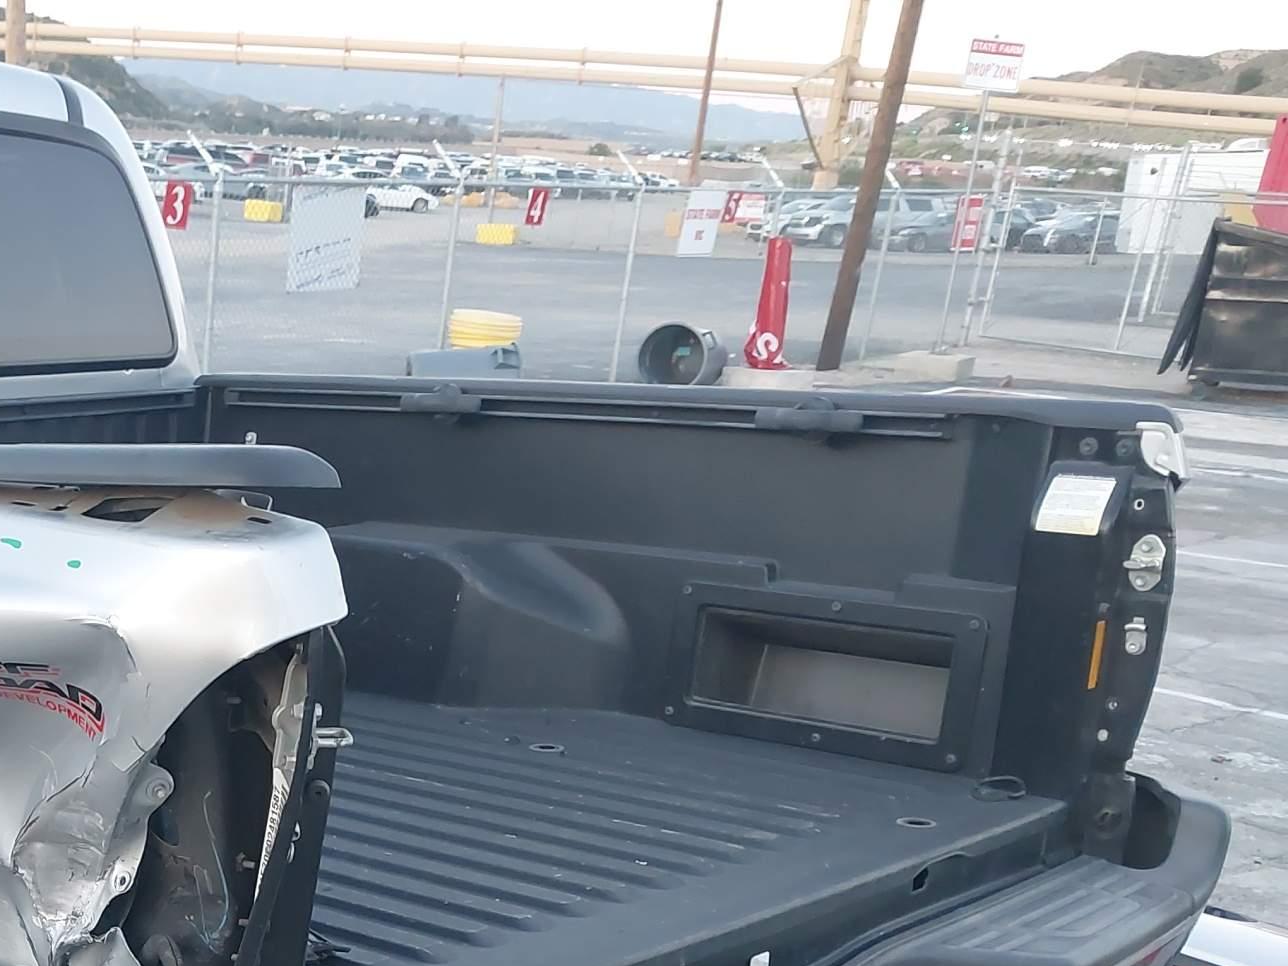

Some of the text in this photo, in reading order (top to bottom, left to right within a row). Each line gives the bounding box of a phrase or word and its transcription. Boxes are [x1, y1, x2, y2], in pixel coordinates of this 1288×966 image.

[972, 42, 1024, 56] STATE FARM
[967, 62, 1018, 80] DROP ZONE
[166, 186, 185, 224] 3
[530, 191, 545, 223] 4
